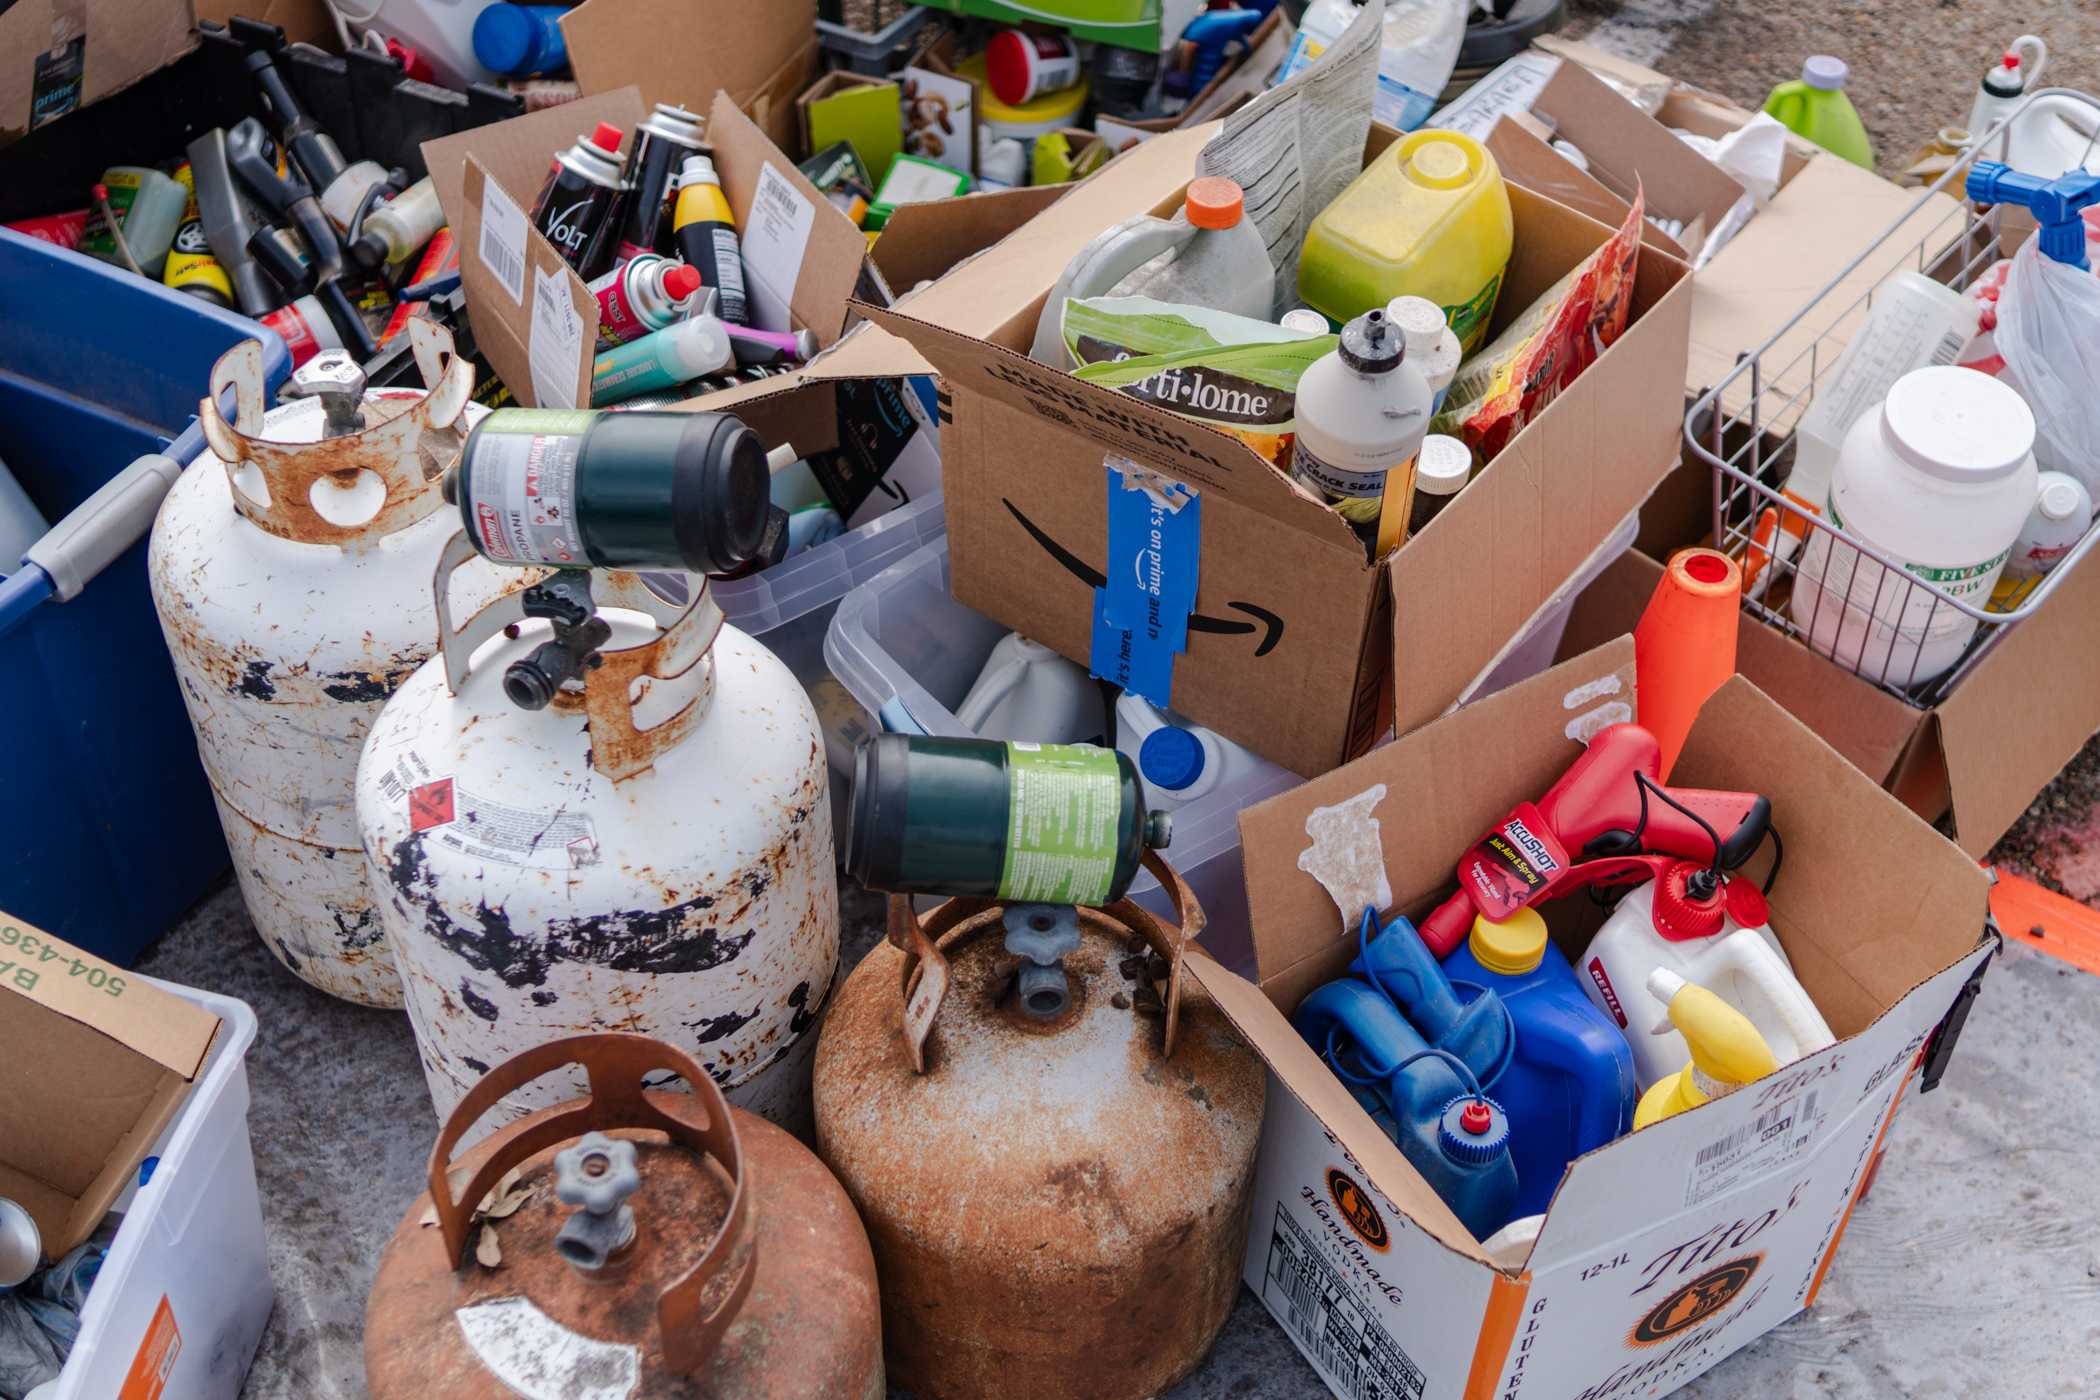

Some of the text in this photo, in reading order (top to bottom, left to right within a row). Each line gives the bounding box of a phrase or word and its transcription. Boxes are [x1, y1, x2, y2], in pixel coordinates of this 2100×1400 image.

[546, 199, 594, 250] VOLT
[1347, 482, 1384, 492] SEAL
[1150, 529, 1163, 550] on
[1147, 549, 1165, 596] prime
[1149, 597, 1163, 627] and
[1501, 847, 1515, 862] Aim
[1517, 861, 1540, 886] Spray
[1507, 819, 1558, 872] ACCUSHOT
[0, 927, 127, 998] 504-436
[1592, 969, 1621, 1016] REFILL
[1300, 1186, 1403, 1305] Handmade
[1322, 1229, 1372, 1293] VODKA
[1630, 1180, 1811, 1297] Tito's
[1300, 1250, 1342, 1304] 38177
[1580, 1252, 1632, 1282] 12-1L
